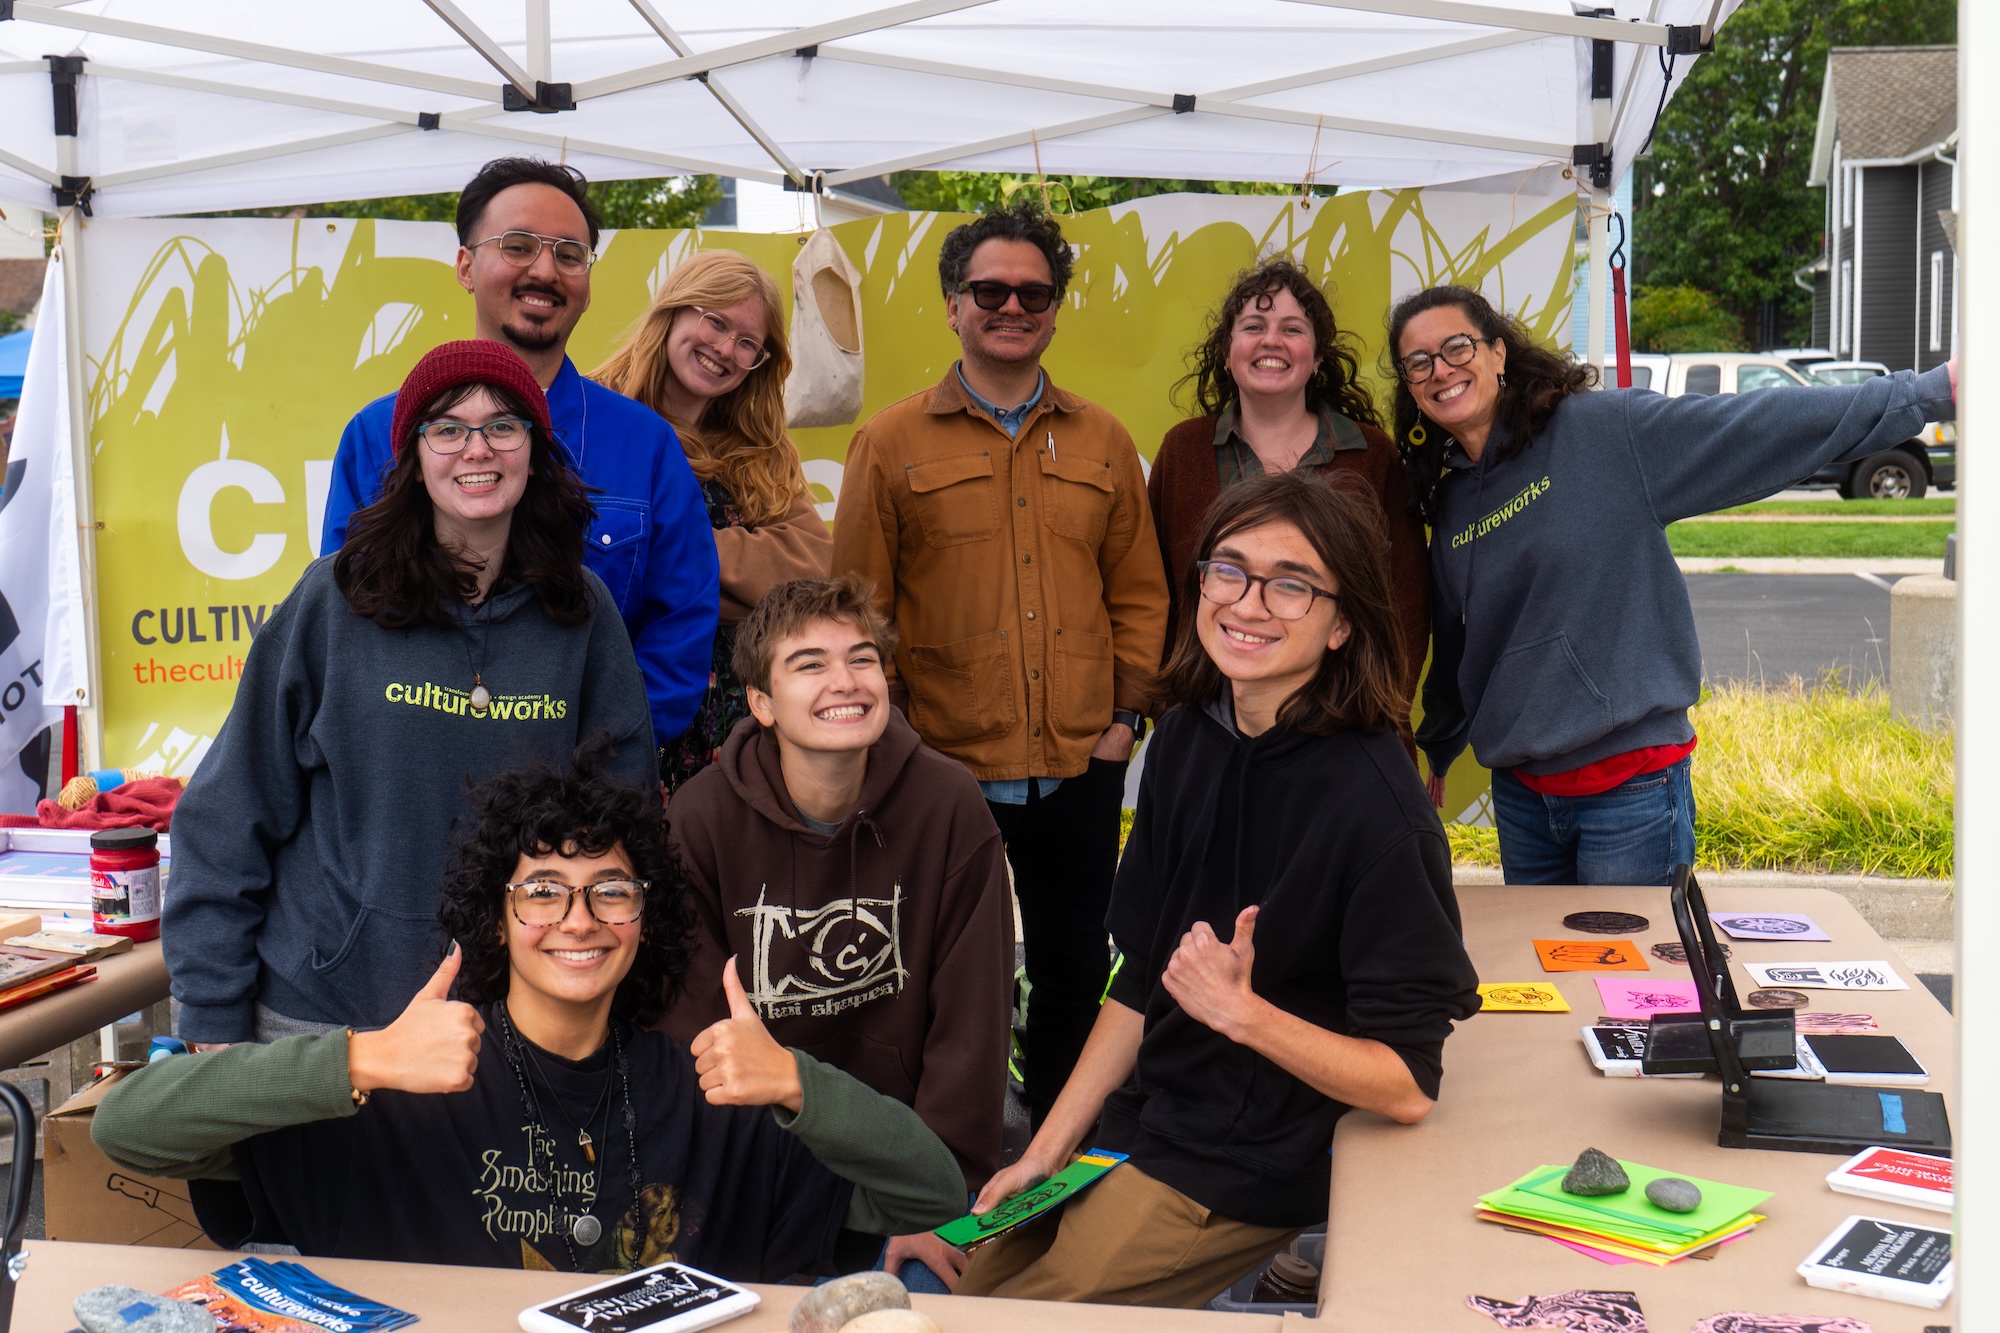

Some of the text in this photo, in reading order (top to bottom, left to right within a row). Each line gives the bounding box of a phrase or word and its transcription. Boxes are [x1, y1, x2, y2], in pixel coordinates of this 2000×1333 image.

[132, 604, 281, 645] CULTIV
[0, 659, 43, 724] OT
[133, 655, 245, 684] thecult
[444, 686, 471, 697] transform
[521, 1124, 556, 1167] The
[472, 1149, 596, 1202] Smashing
[481, 1194, 580, 1243] Pumpkin
[240, 1276, 353, 1333] cultureworks
[575, 1297, 621, 1313] INK
[594, 1273, 699, 1320] ARCHIVAL
